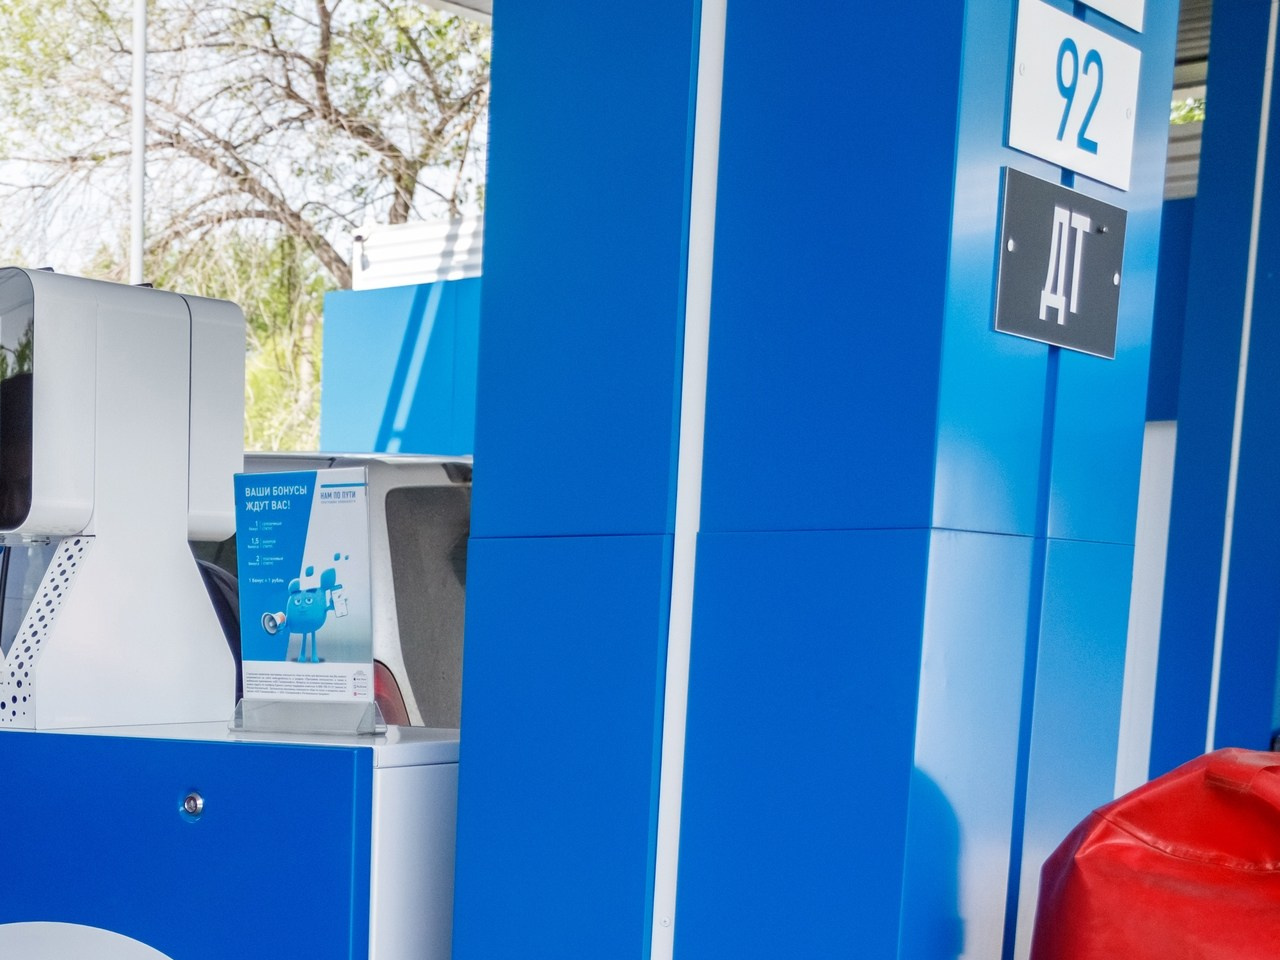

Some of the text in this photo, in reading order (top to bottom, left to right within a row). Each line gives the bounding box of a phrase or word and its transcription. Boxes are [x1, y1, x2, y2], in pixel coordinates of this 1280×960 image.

[1056, 37, 1104, 155] 92
[1039, 204, 1091, 325] ДТ
[245, 485, 307, 497] ВАШИ БОНУСЫ
[320, 490, 356, 500] НАМ ПО ПУТИ
[245, 499, 291, 512] ЖДУТ ВАС!
